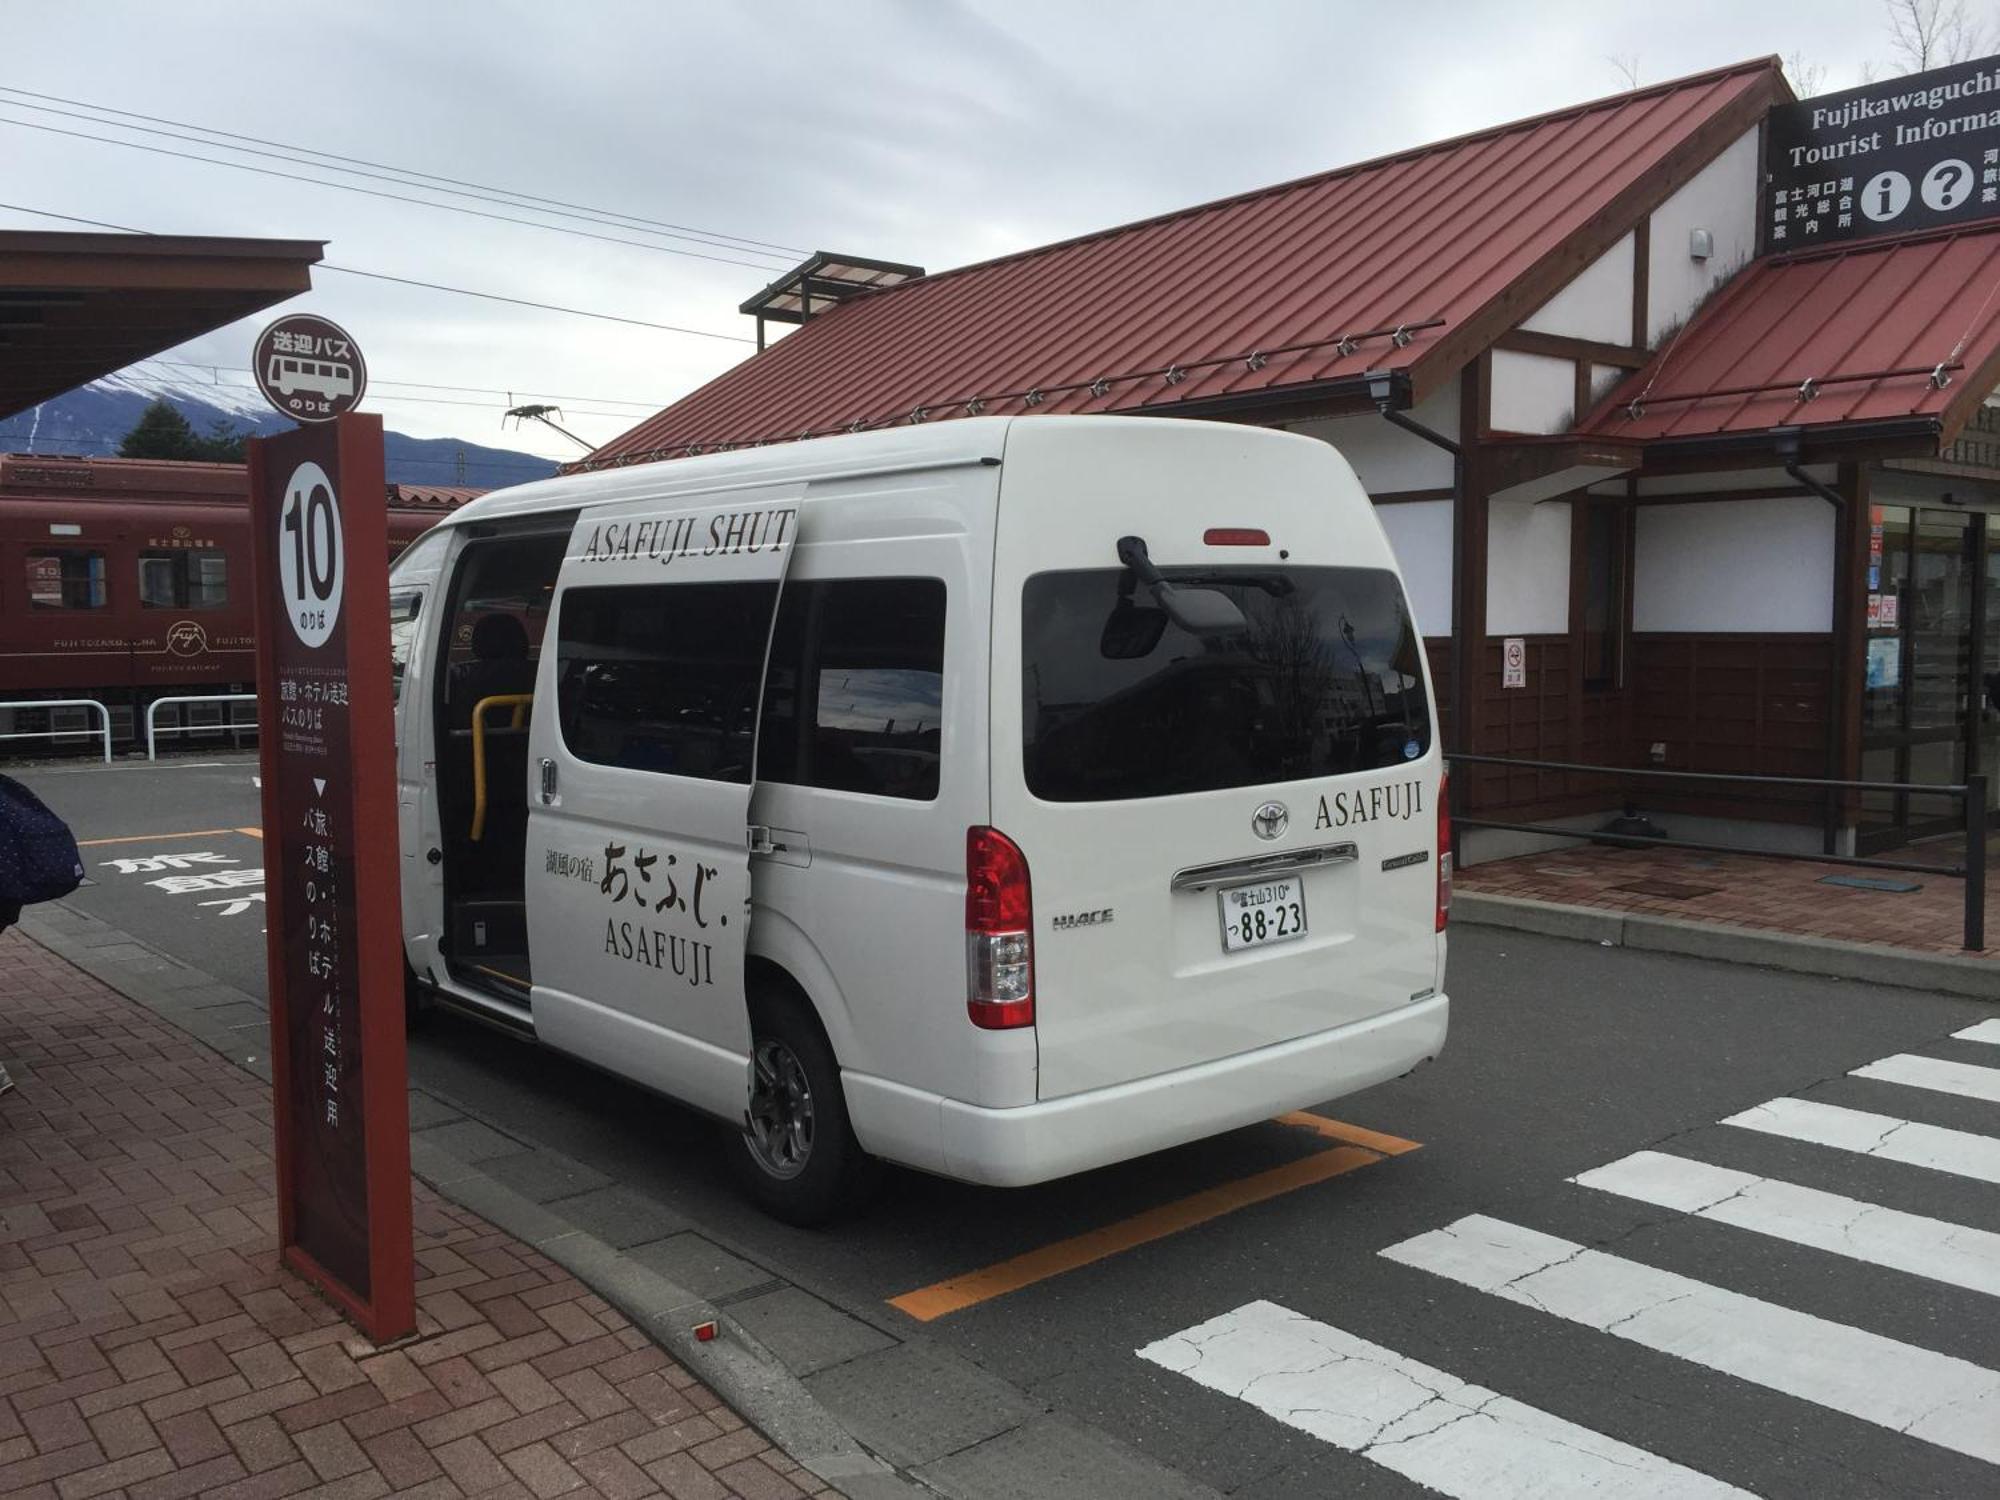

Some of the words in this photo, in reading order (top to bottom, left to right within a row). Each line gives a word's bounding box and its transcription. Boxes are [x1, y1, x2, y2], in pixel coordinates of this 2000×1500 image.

[1812, 68, 2000, 130] Fujikawaguchi
[1790, 131, 1882, 168] Tourist
[1895, 110, 2000, 146] Informa
[1775, 177, 1853, 205] 富士河口湖
[1774, 195, 1852, 223] 観光総合
[1773, 213, 1852, 240] 案内所
[273, 330, 351, 359] 送迎バス
[289, 398, 331, 413] のりば
[285, 484, 336, 601] 10
[300, 609, 325, 630] のりば
[282, 706, 323, 730] バスのりば
[1314, 781, 1422, 830] ASAFUJI
[303, 808, 321, 976] バスのりば
[1241, 903, 1301, 943] 88-23
[605, 917, 714, 986] ASAFUJI
